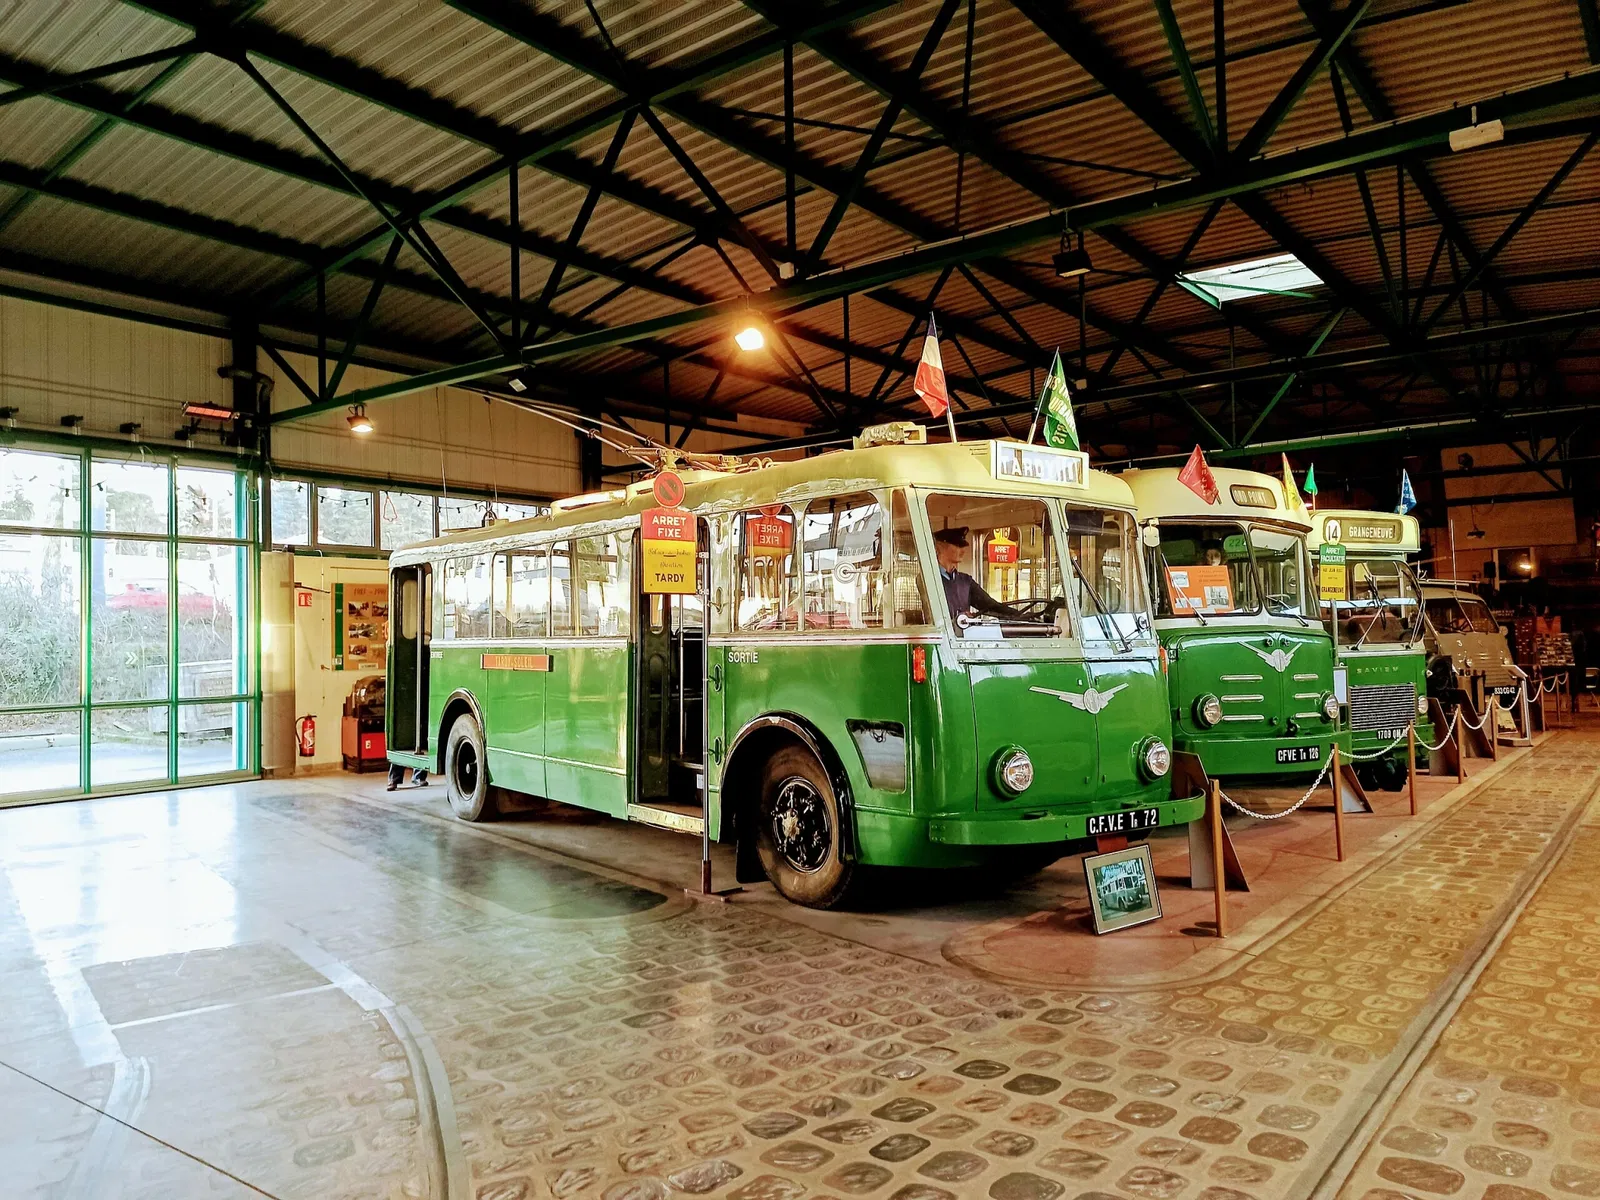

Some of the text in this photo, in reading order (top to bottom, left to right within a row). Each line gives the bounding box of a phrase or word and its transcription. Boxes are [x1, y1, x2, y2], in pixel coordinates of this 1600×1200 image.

[1248, 490, 1267, 504] POINT
[652, 515, 687, 526] ARRET
[657, 527, 682, 538] FIXE
[1328, 525, 1338, 541] 14
[1348, 526, 1393, 539] GRANGENEUVE
[994, 545, 1010, 554] ARRET
[1325, 547, 1340, 555] ARRET
[996, 554, 1008, 562] FIXE
[655, 573, 685, 583] TARDY
[728, 651, 759, 663] SORTIE
[1356, 666, 1399, 674] SAVIEM
[1277, 749, 1297, 761] CFVE
[1309, 747, 1319, 760] 126
[1143, 808, 1157, 826] 72
